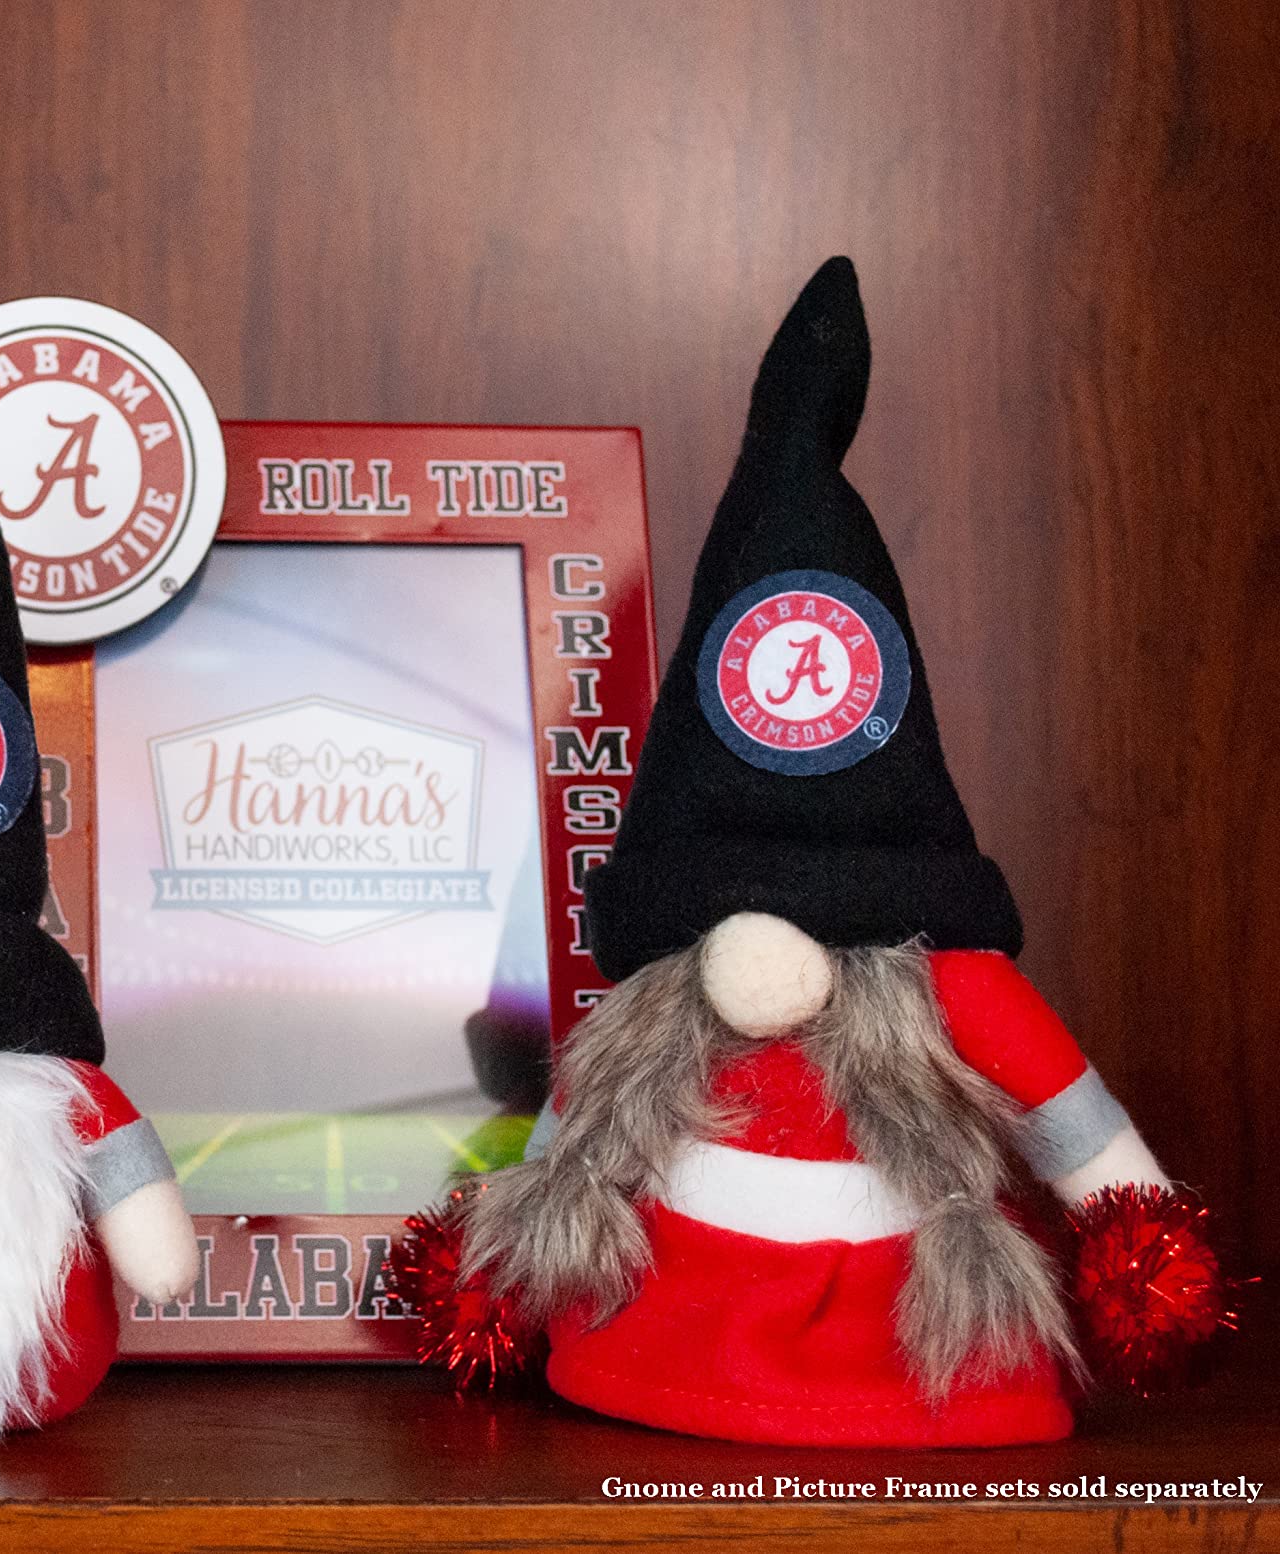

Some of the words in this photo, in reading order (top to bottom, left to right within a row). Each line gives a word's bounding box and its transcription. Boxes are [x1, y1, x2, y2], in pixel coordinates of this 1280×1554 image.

[258, 457, 410, 516] ROLL
[426, 460, 568, 518] TIDE
[102, 487, 176, 576] TIDE
[726, 600, 866, 672] ALABAMA
[765, 634, 834, 706] A
[731, 694, 835, 744] CRIMSON
[835, 672, 875, 725] TIDE
[183, 739, 459, 833] Hanna's
[545, 553, 633, 955] CRIMS
[185, 834, 399, 865] HANDIWORKS,
[409, 836, 454, 863] LLC
[160, 876, 302, 901] LICENSED
[308, 878, 483, 902] COLLEGIATE
[130, 1234, 424, 1320] LABA
